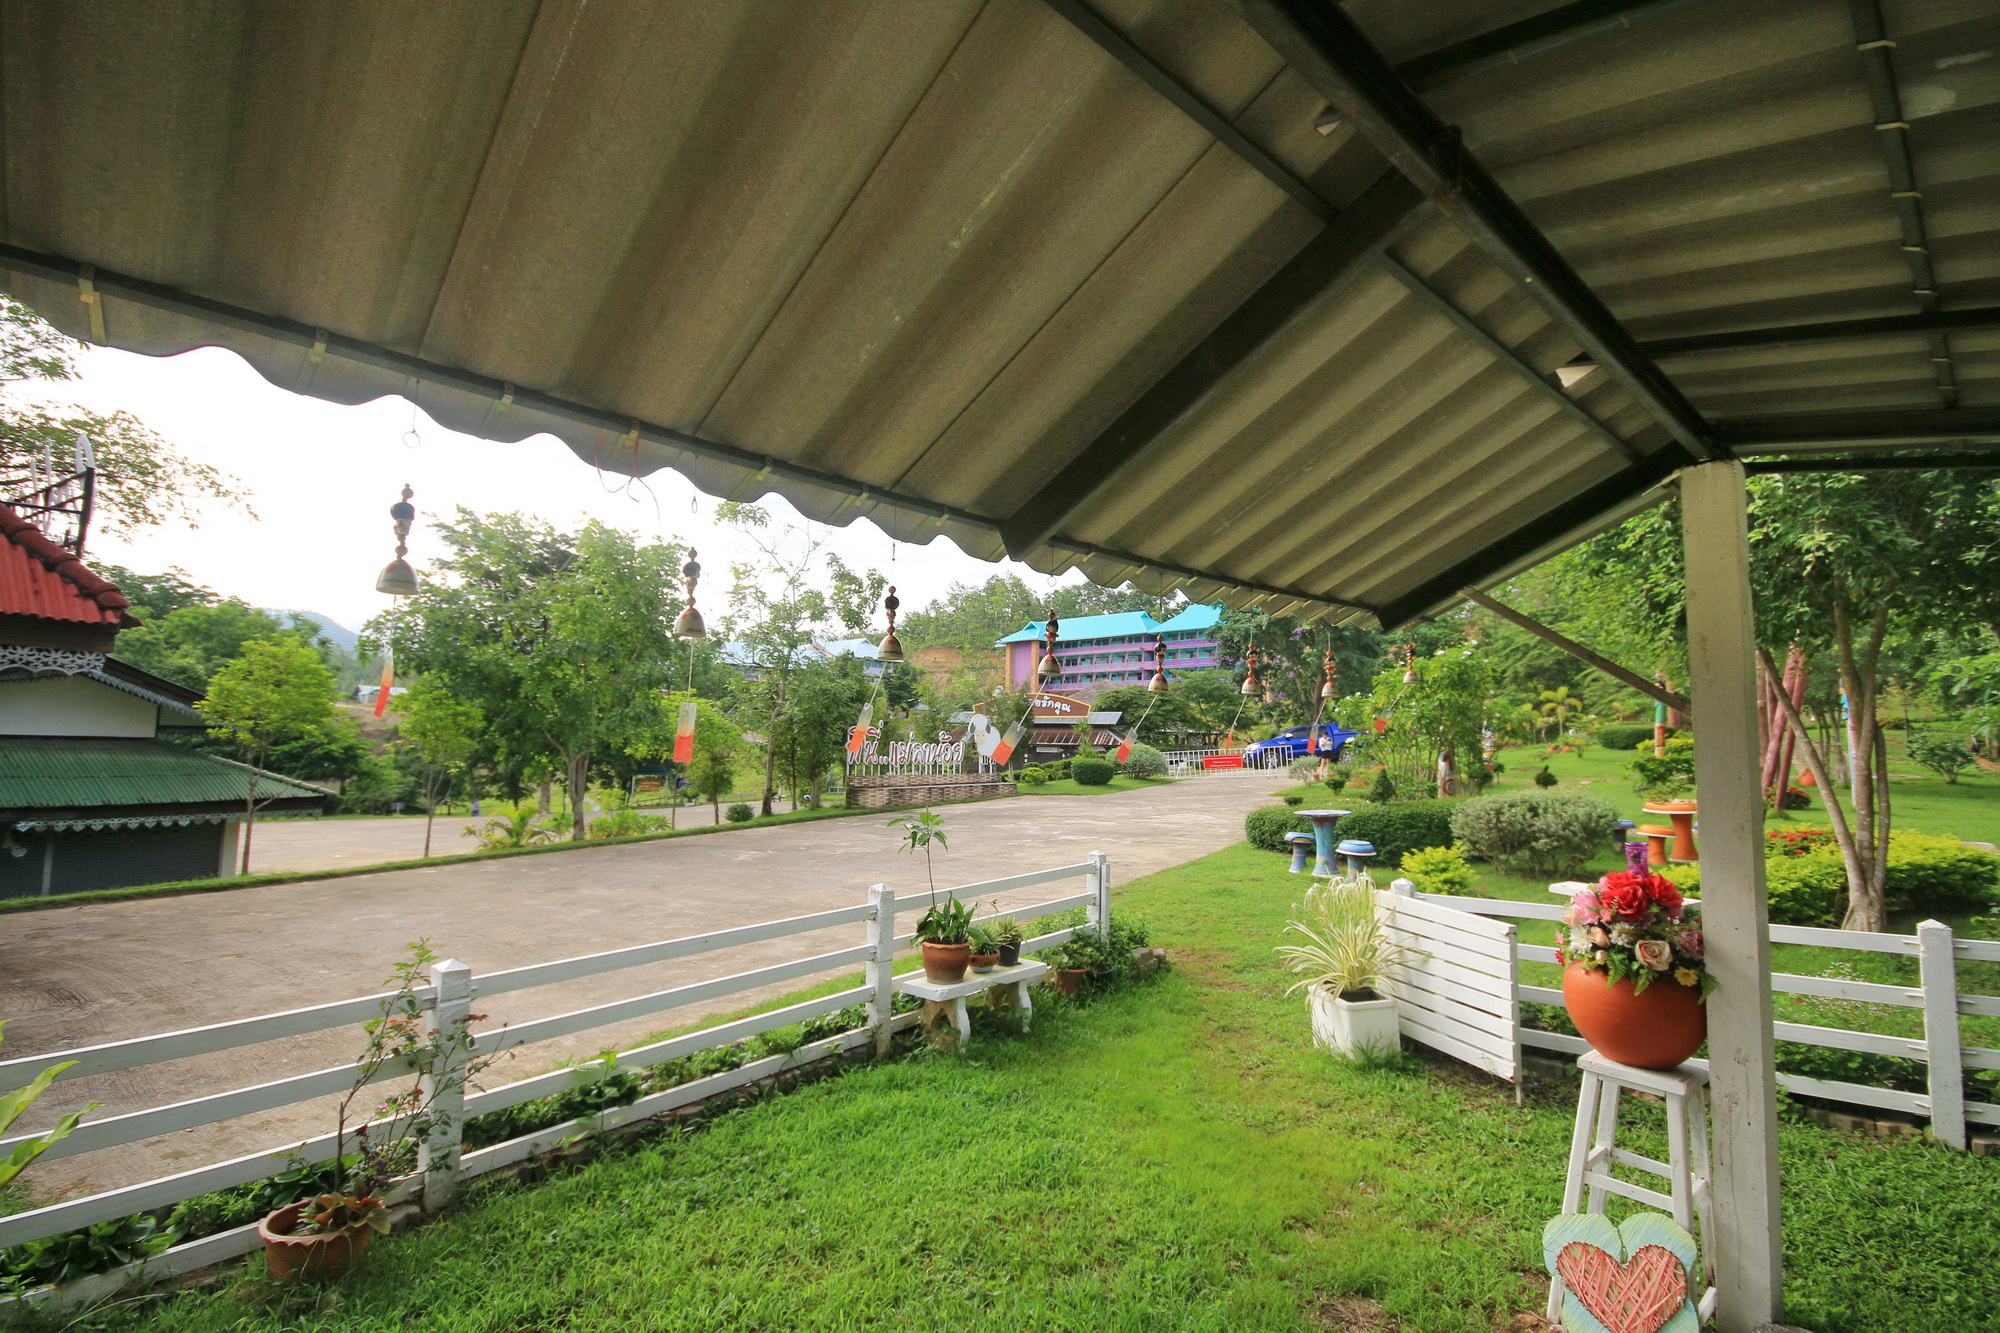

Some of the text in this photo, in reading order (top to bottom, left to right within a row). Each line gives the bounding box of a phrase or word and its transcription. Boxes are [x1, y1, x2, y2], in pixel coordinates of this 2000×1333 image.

[845, 719, 965, 767] นี่..แม่ลาน้อย
